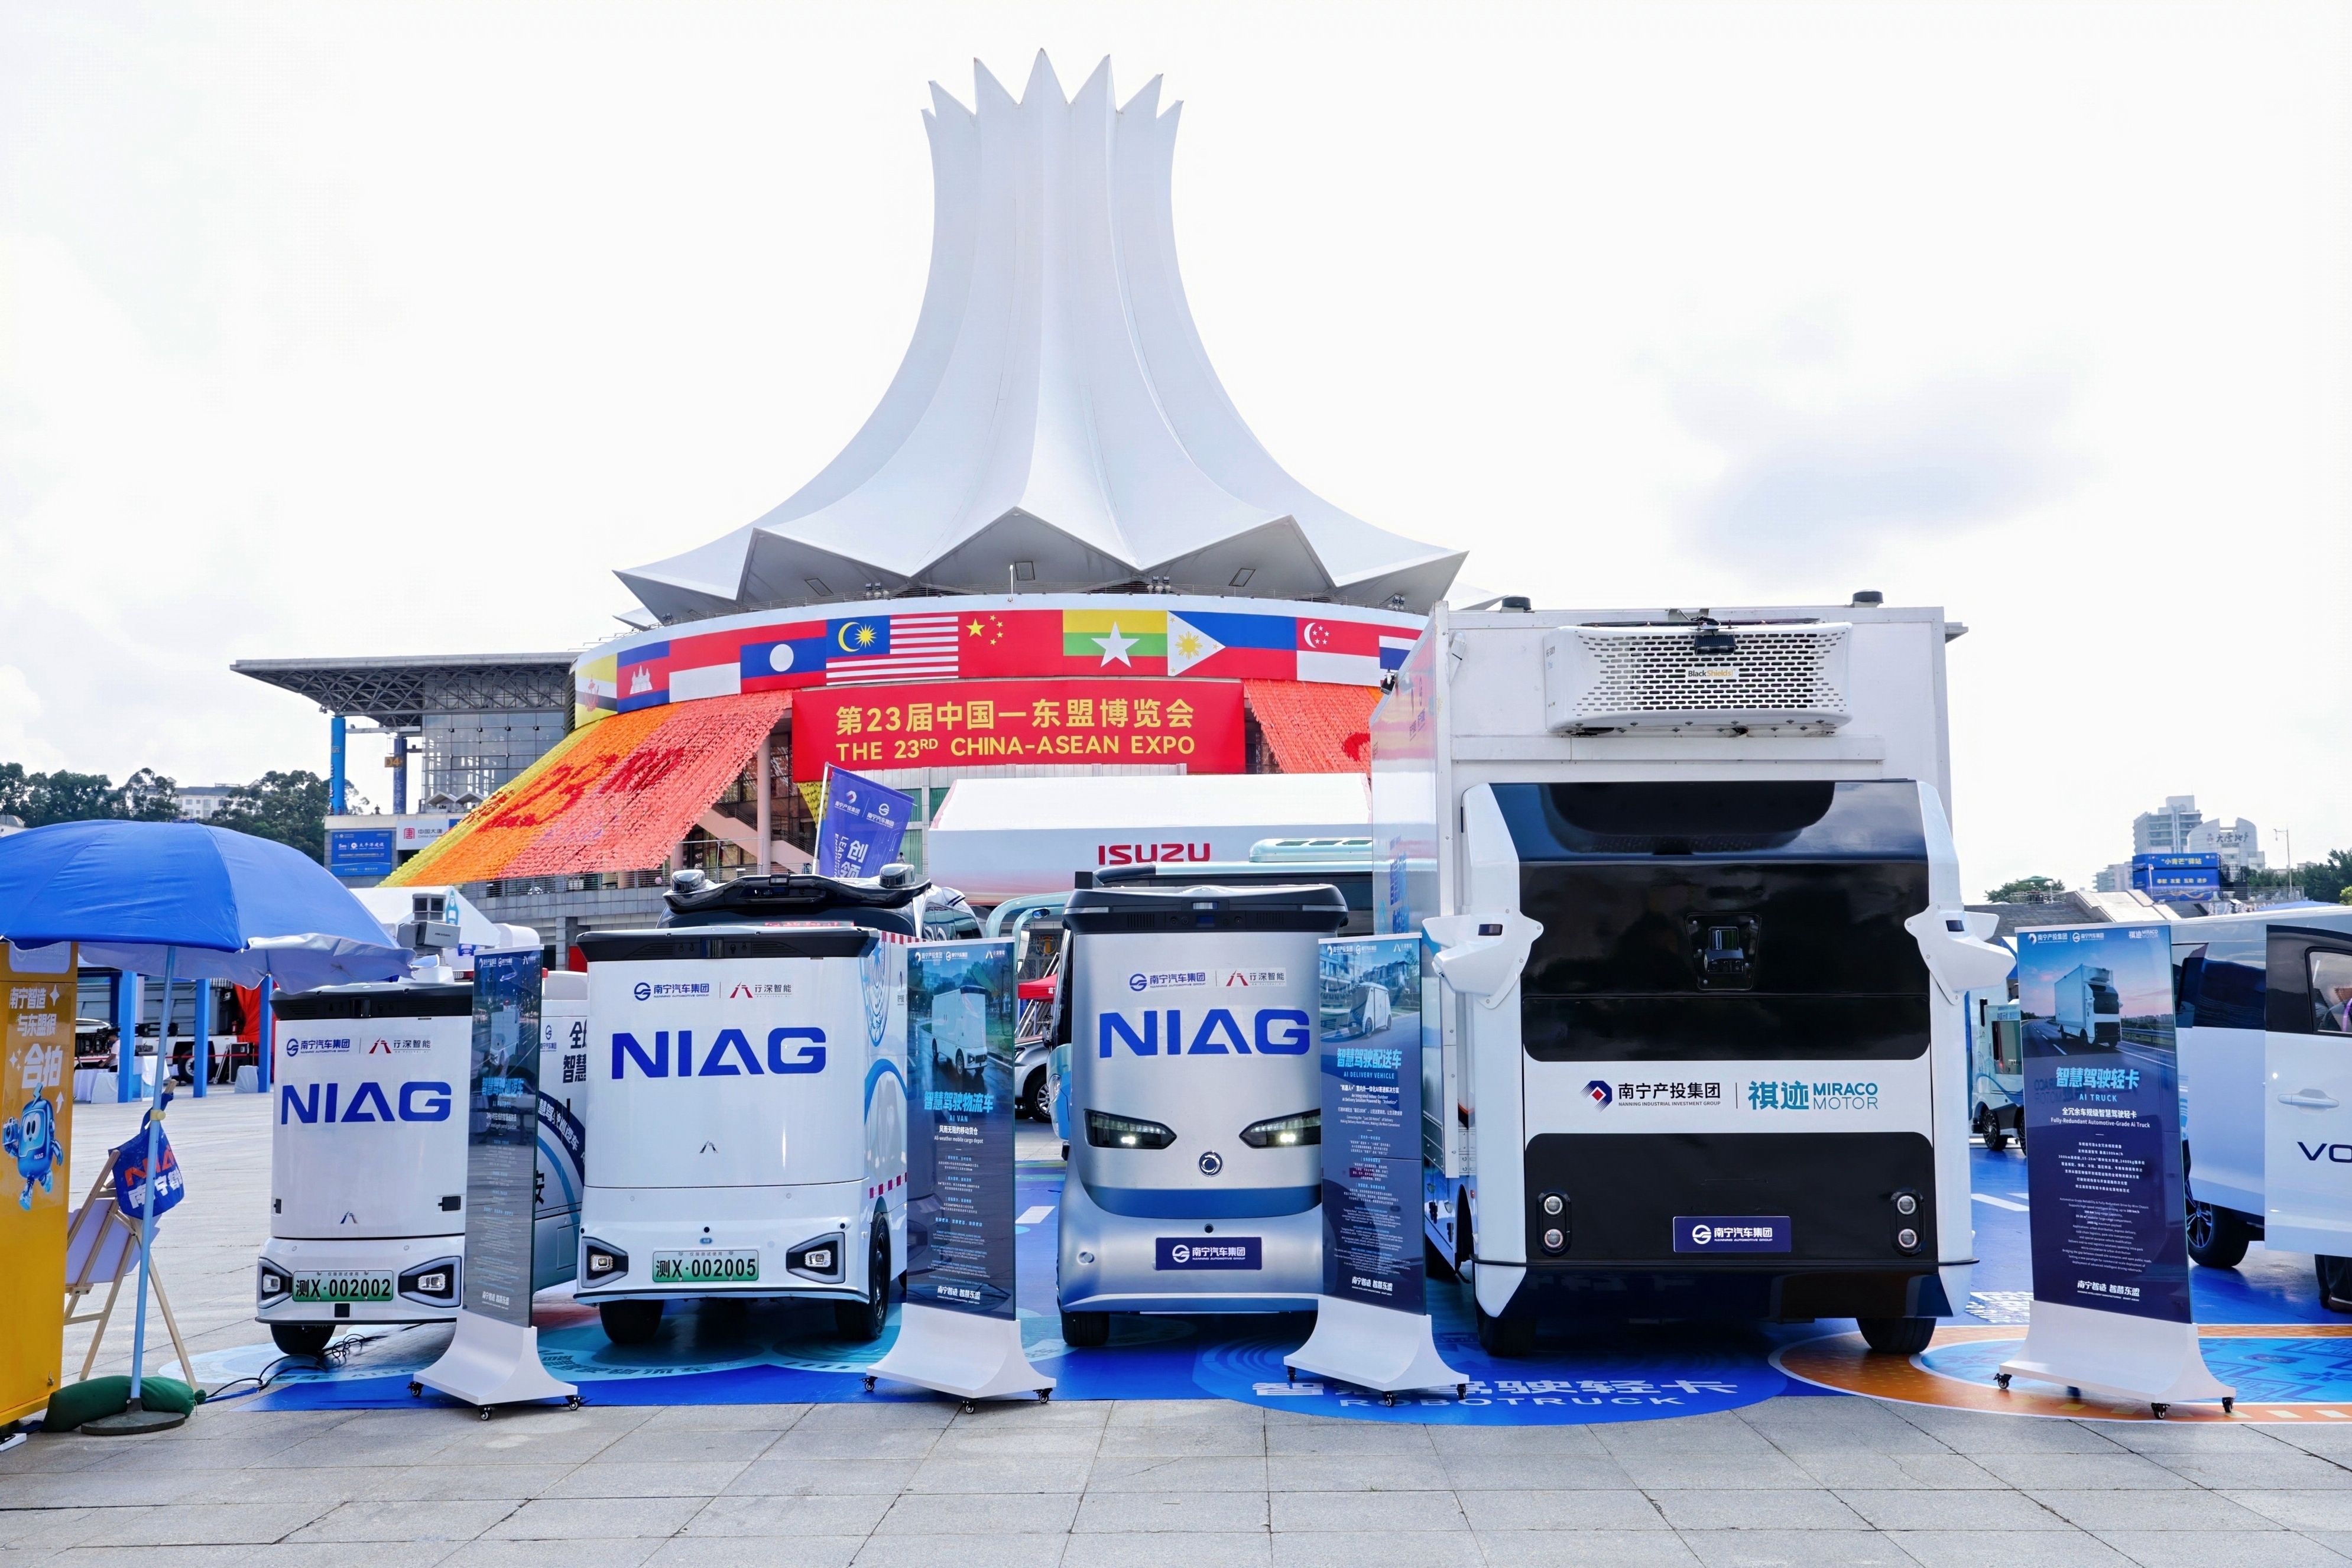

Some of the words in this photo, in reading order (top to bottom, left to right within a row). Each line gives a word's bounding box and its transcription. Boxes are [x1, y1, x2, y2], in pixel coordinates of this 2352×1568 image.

[836, 742, 883, 762] THE
[894, 738, 939, 759] 23RD
[951, 735, 1120, 757] CHINA-ASEAN
[1131, 735, 1195, 755] EXPO
[386, 757, 400, 767] D4
[835, 801, 861, 814] 南宁产投集团
[867, 813, 894, 827] 南宁汽车集团
[1098, 843, 1211, 865] ISUZU
[2129, 931, 2142, 939] 祺迹
[922, 952, 943, 960] 南宁产投集团
[1150, 972, 1206, 985] 南宁汽车集团
[1249, 972, 1284, 981] 行深智能
[654, 983, 709, 994] 南宁汽车集团
[754, 984, 792, 994] 行深智能
[9, 987, 46, 1009] 南宁智造
[17, 1014, 57, 1037] 与东盟很
[1099, 1008, 1310, 1059] NIAG
[300, 1038, 351, 1050] 南宁汽车集团
[393, 1040, 431, 1049] 行深智能
[611, 1027, 826, 1080] NIAG
[1337, 1048, 1403, 1069] 智慧驾驶配送车
[22, 1043, 63, 1089] 合拍
[2056, 1067, 2140, 1089] 智慧驾驶轻卡
[1618, 1082, 1721, 1099] 南宁产投集团
[1748, 1080, 1809, 1110] 祺迹
[1813, 1082, 1878, 1096] MIRACO
[281, 1081, 452, 1125] NIAG
[924, 1090, 994, 1113] 智慧驾驶物流车
[1813, 1097, 1878, 1110] MOTOR
[2090, 1094, 2117, 1102] TRUCK
[2062, 1107, 2137, 1119] 全冗余车规级智慧驾驶轻卡
[538, 1098, 580, 1151] 慧驾驶巡逻车
[939, 1125, 978, 1135] 风雨无阻的移动货仓
[1714, 1227, 1773, 1239] 南宁汽车集团
[1192, 1247, 1245, 1257] 南宁汽车集团
[656, 1258, 756, 1278] 测X·002005
[296, 1278, 391, 1298] 测X·002002
[1352, 1276, 1371, 1287] 南宁智造
[1373, 1279, 1393, 1291] 智慧东盟
[2077, 1280, 2107, 1292] 南宁智造
[2110, 1284, 2140, 1297] 智慧东盟
[937, 1285, 958, 1296] 南宁智造
[960, 1288, 981, 1300] 智慧东盟
[1253, 1380, 1738, 1395] 智驾驶轻卡
